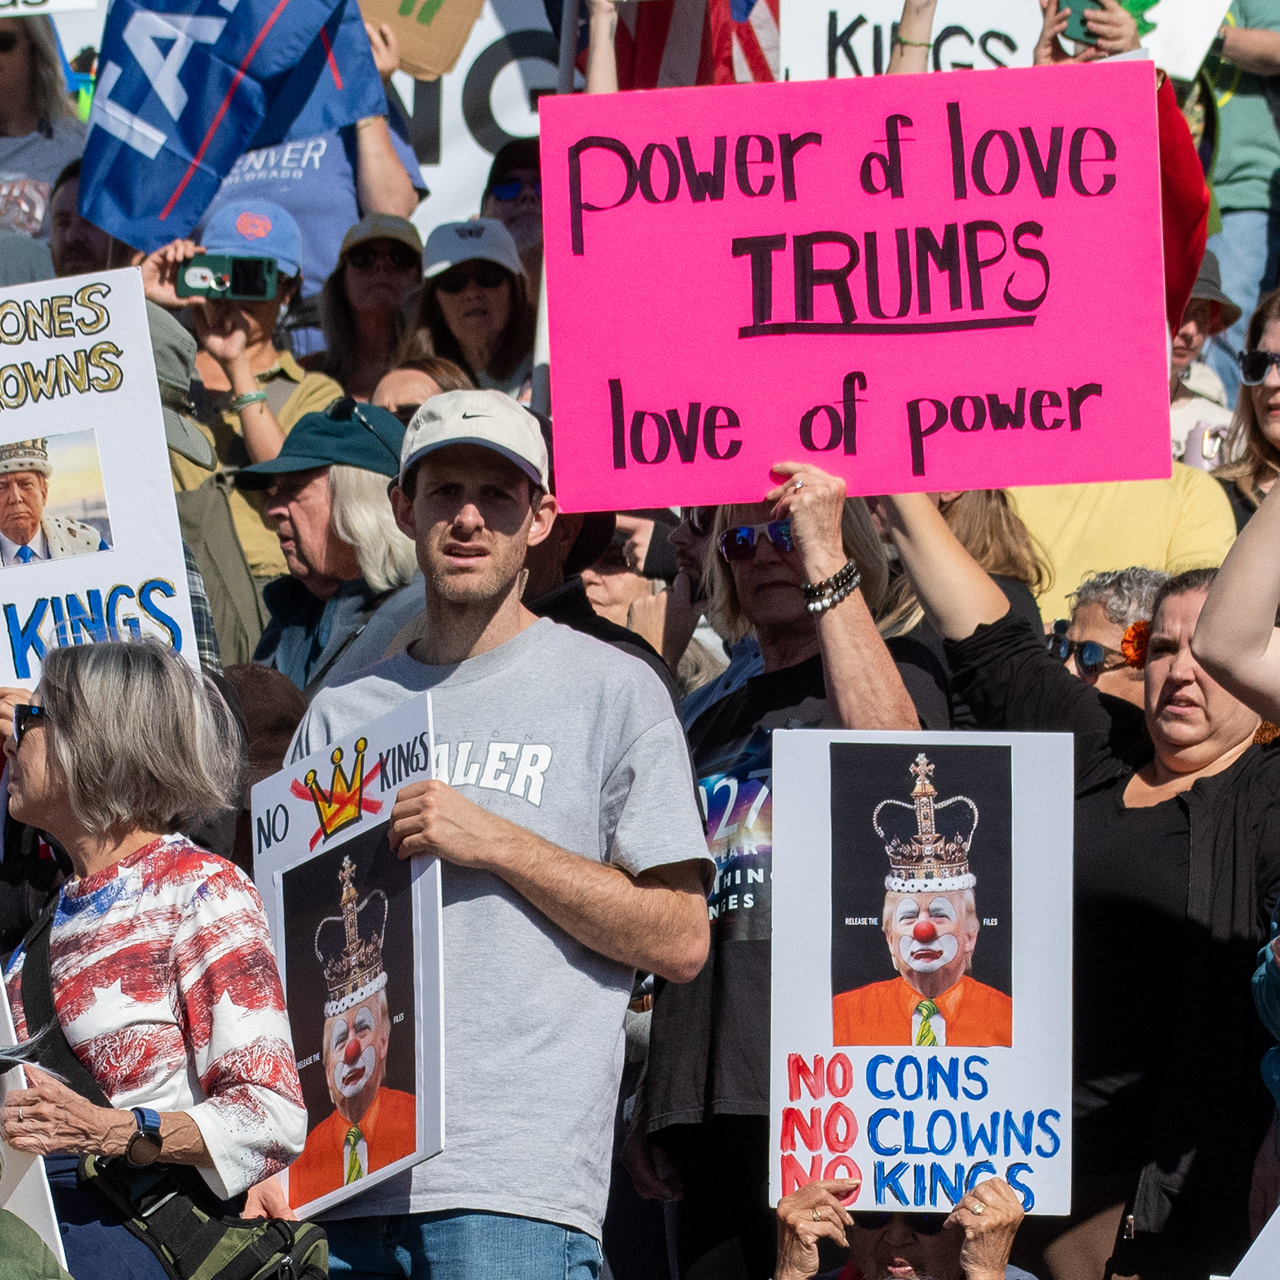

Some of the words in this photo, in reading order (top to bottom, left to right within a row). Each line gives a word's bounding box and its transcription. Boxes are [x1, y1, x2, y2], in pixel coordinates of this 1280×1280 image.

[568, 132, 822, 256] power
[859, 114, 915, 199] of
[946, 102, 1118, 200] love
[732, 220, 1050, 324] TRUMPS
[608, 378, 742, 469] love
[798, 370, 868, 456] of
[908, 382, 1103, 476] power
[378, 731, 430, 793] KINGS
[433, 741, 553, 808] ALER
[256, 803, 289, 855] NO
[787, 1052, 853, 1101] NO
[866, 1054, 989, 1101] CONS
[780, 1102, 858, 1155] NO
[868, 1108, 1061, 1158] CLOWNS
[781, 1154, 862, 1207] NO
